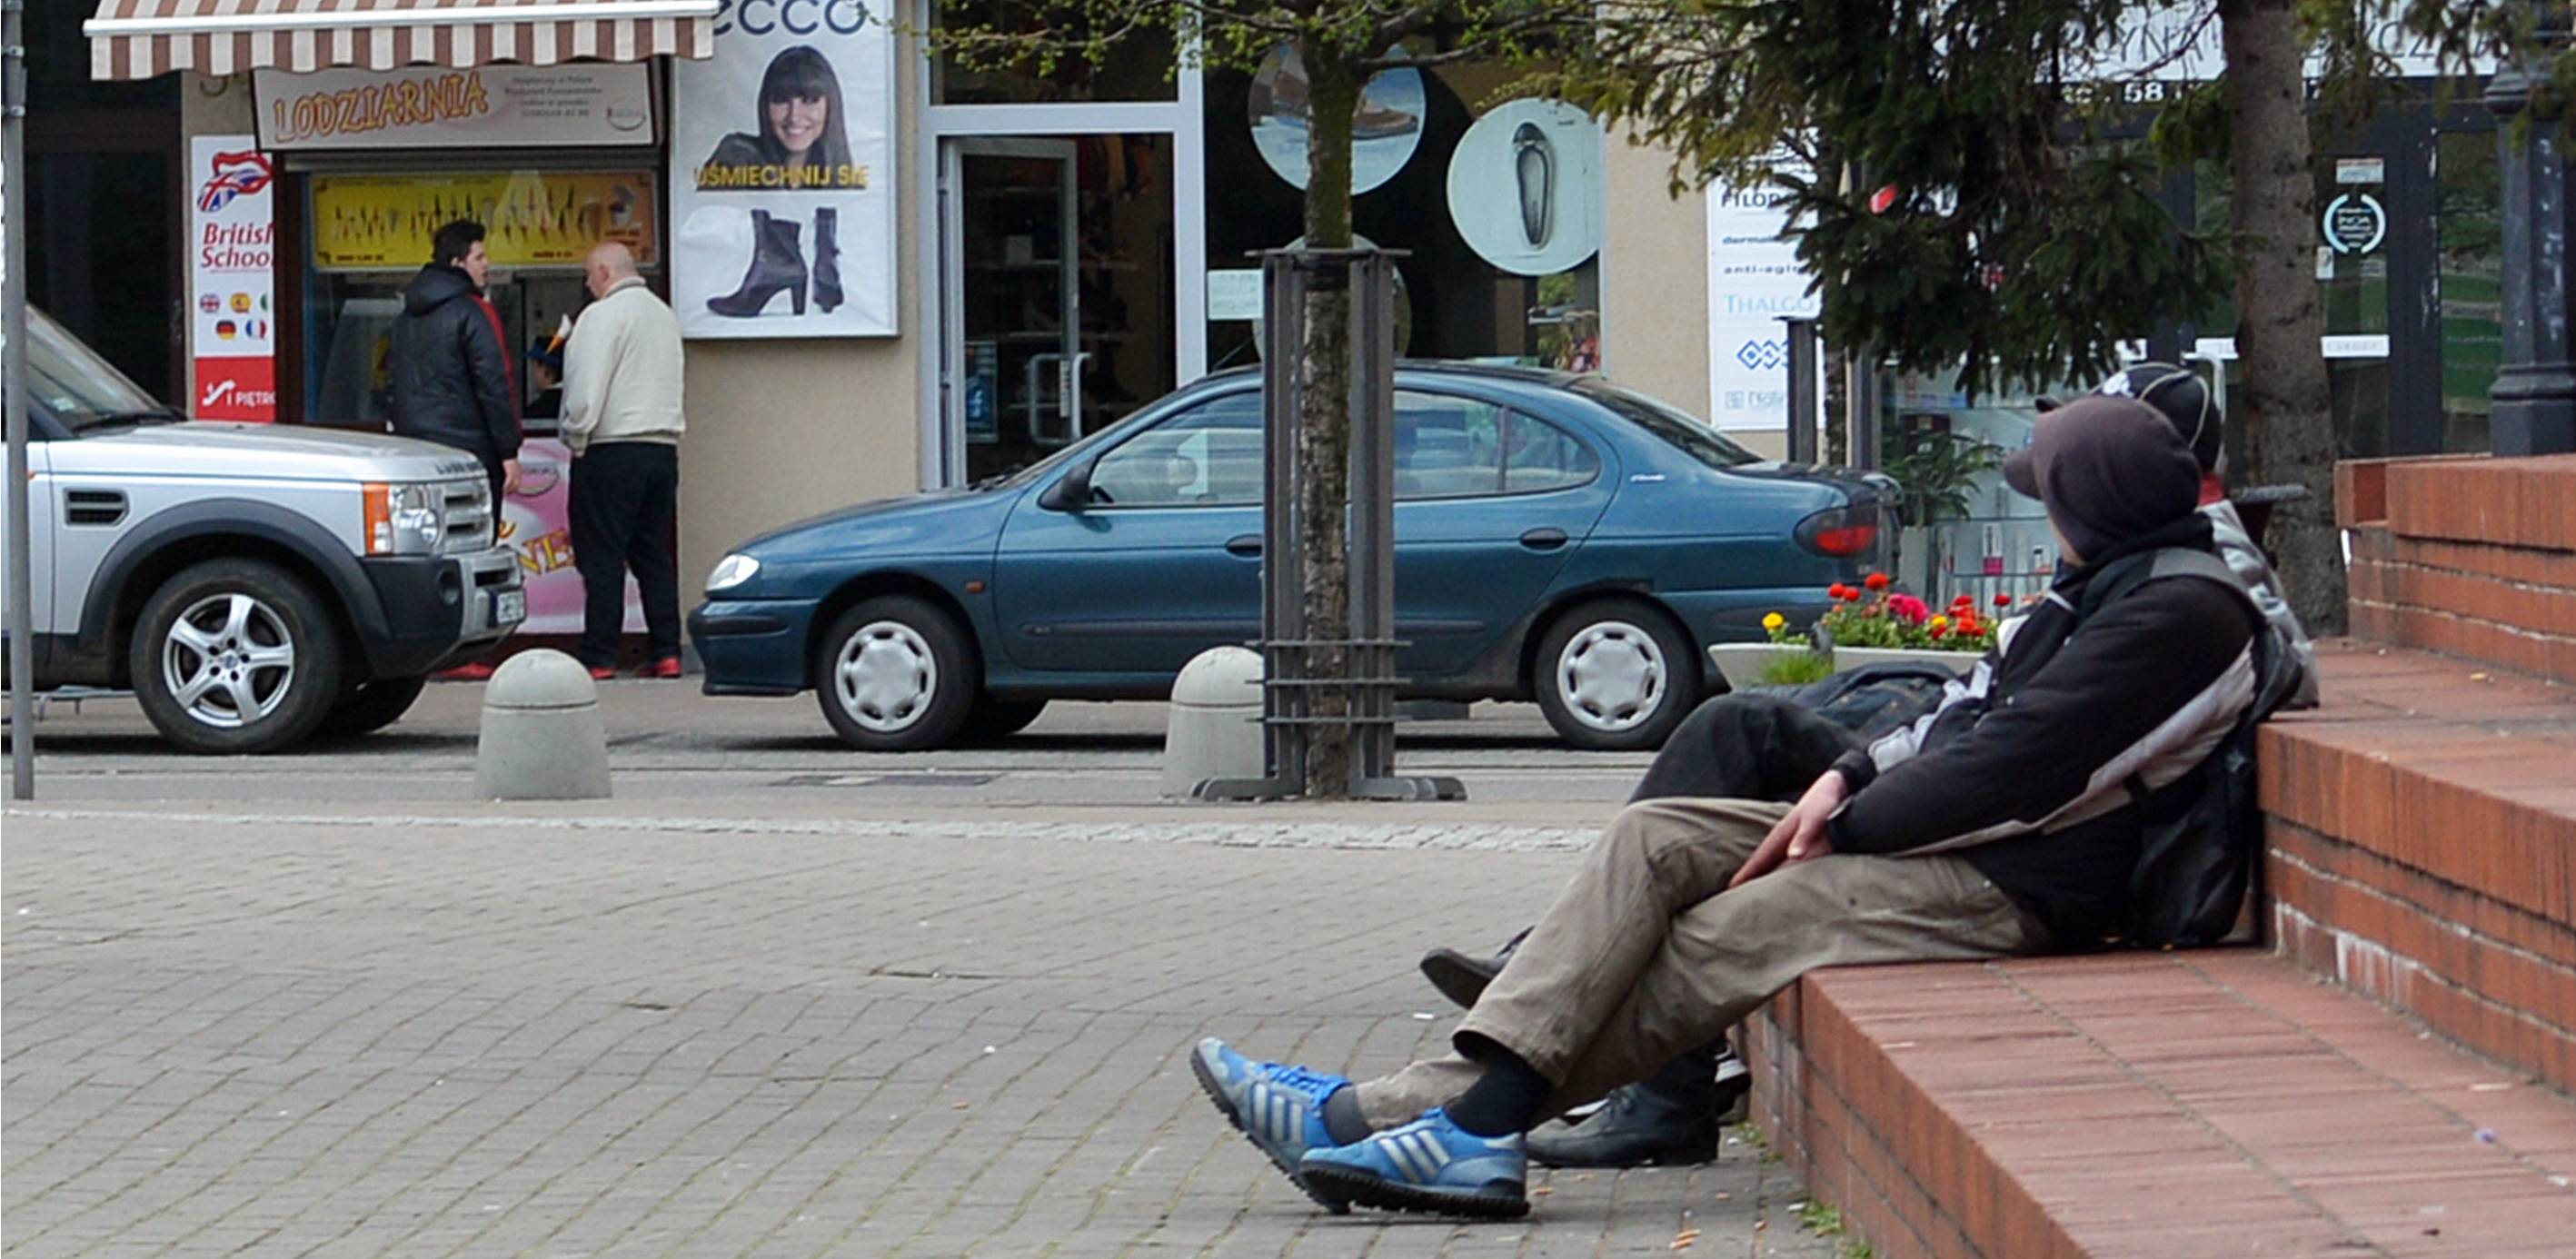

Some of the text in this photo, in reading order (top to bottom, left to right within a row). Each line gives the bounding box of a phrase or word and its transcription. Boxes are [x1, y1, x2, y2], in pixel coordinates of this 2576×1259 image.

[2123, 82, 2164, 103] 58
[274, 70, 489, 144] LODZIARNIA
[201, 246, 274, 268] Schoo
[1726, 293, 1815, 312] THALGO
